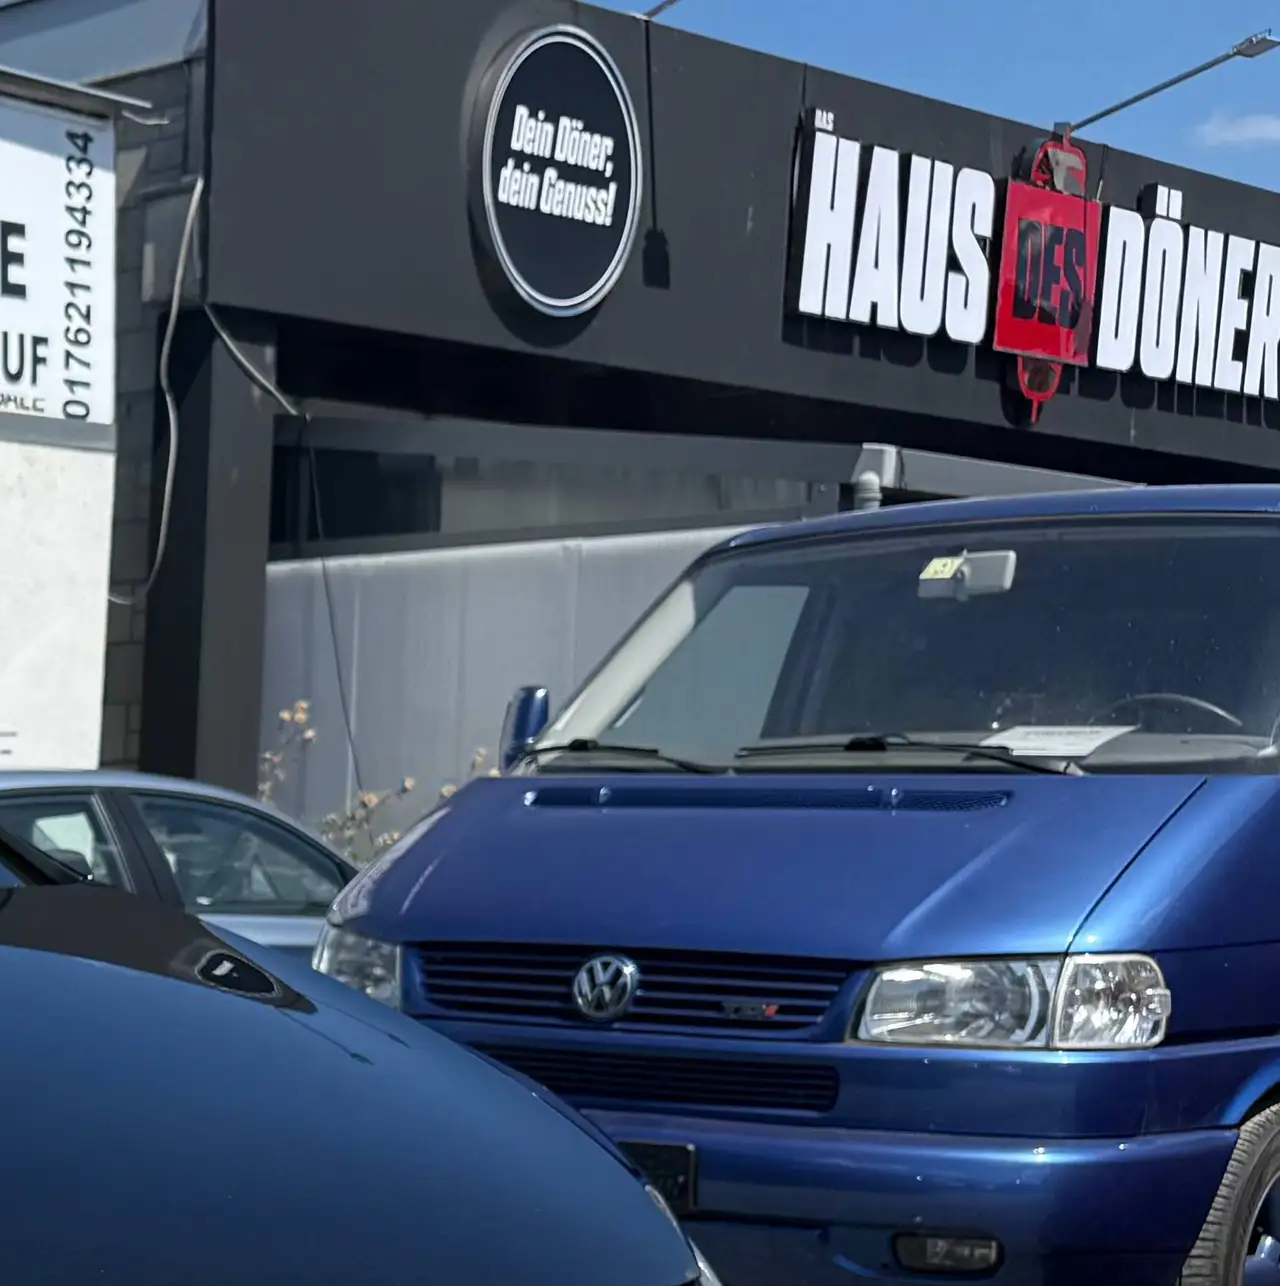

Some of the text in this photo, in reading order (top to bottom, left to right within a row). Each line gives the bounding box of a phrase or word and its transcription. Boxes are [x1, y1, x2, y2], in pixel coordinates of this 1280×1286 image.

[498, 157, 618, 227] dein Genuss!
[510, 104, 614, 178] Dein Döner,
[62, 130, 94, 420] 017621194334
[799, 131, 1280, 400] HAUS DES DÖNER
